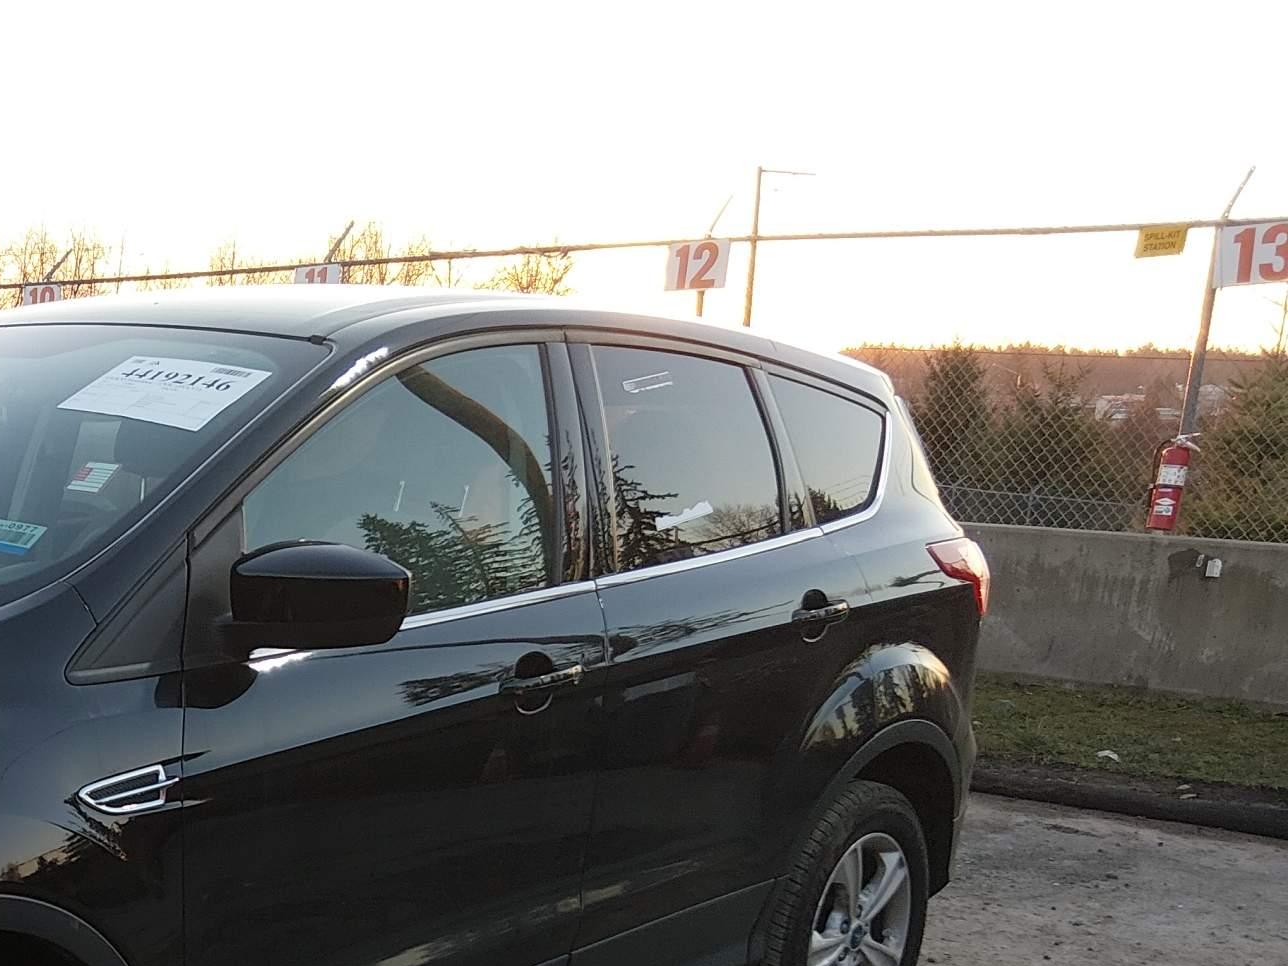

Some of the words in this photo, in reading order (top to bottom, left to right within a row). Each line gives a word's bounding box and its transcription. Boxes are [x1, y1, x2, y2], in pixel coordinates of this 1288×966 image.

[1144, 230, 1181, 242] SPILL-KIT
[1143, 240, 1177, 252] STATION
[675, 241, 719, 289] 12
[29, 286, 55, 304] 10
[121, 367, 231, 392] 44192146
